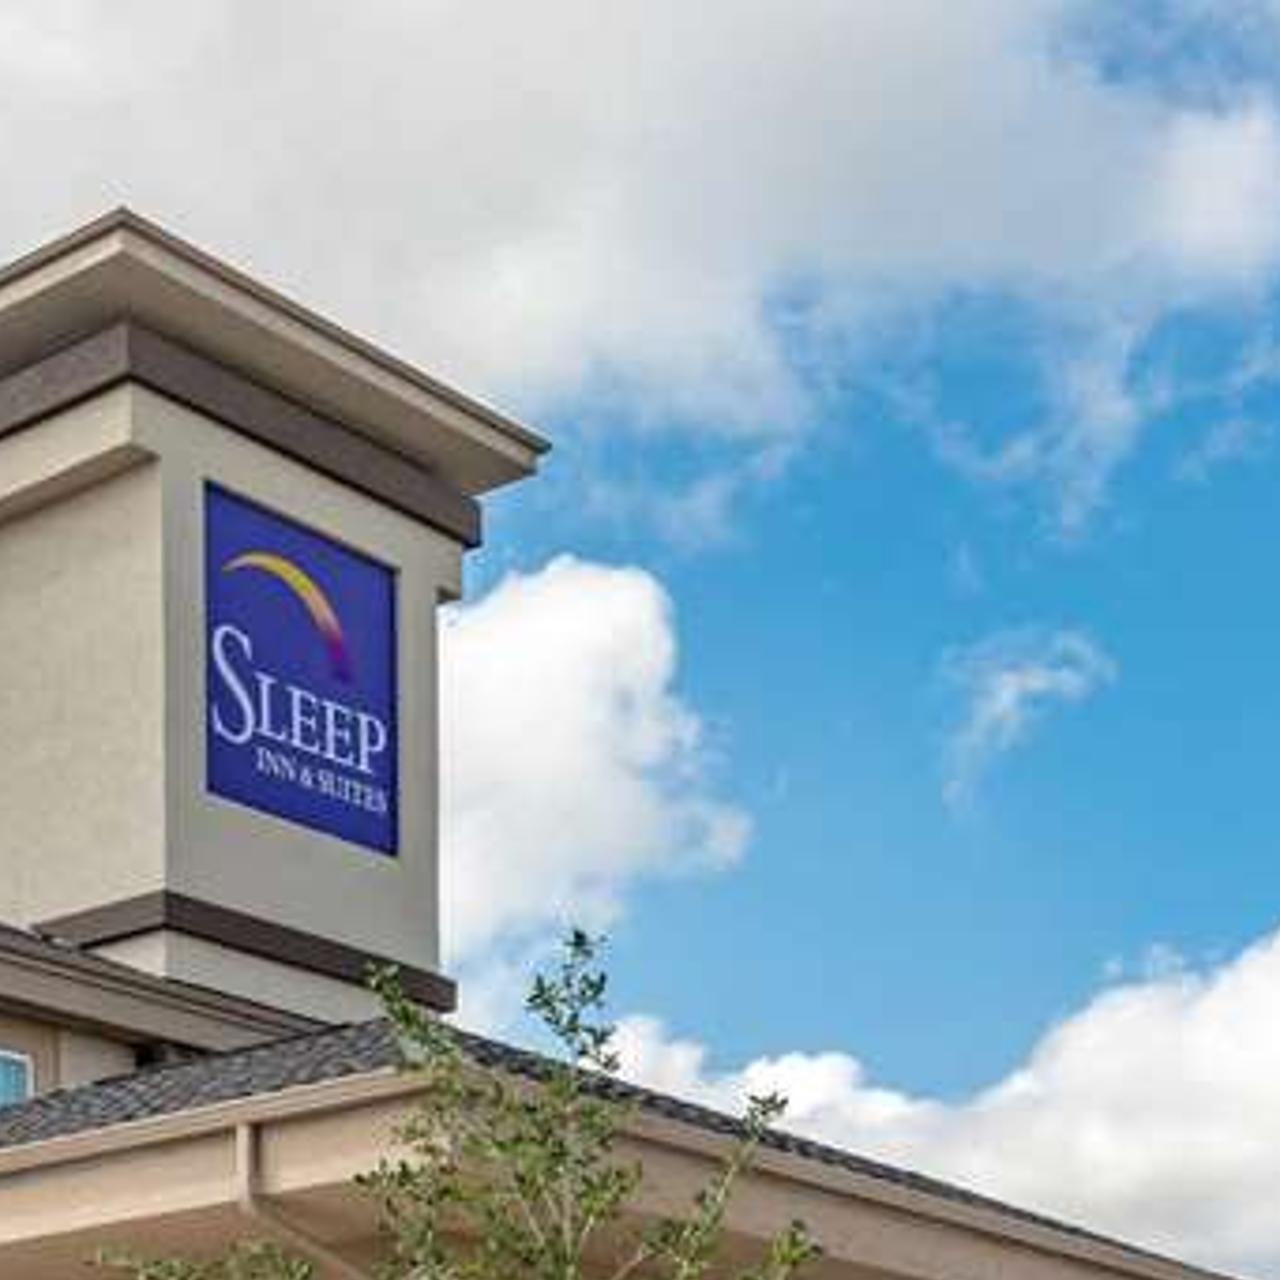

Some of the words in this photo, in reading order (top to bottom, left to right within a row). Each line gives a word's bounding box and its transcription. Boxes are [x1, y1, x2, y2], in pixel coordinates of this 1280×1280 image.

[212, 624, 388, 775] SLEEP
[255, 746, 297, 782] INN
[300, 767, 313, 789] &
[318, 768, 388, 813] SUITES
